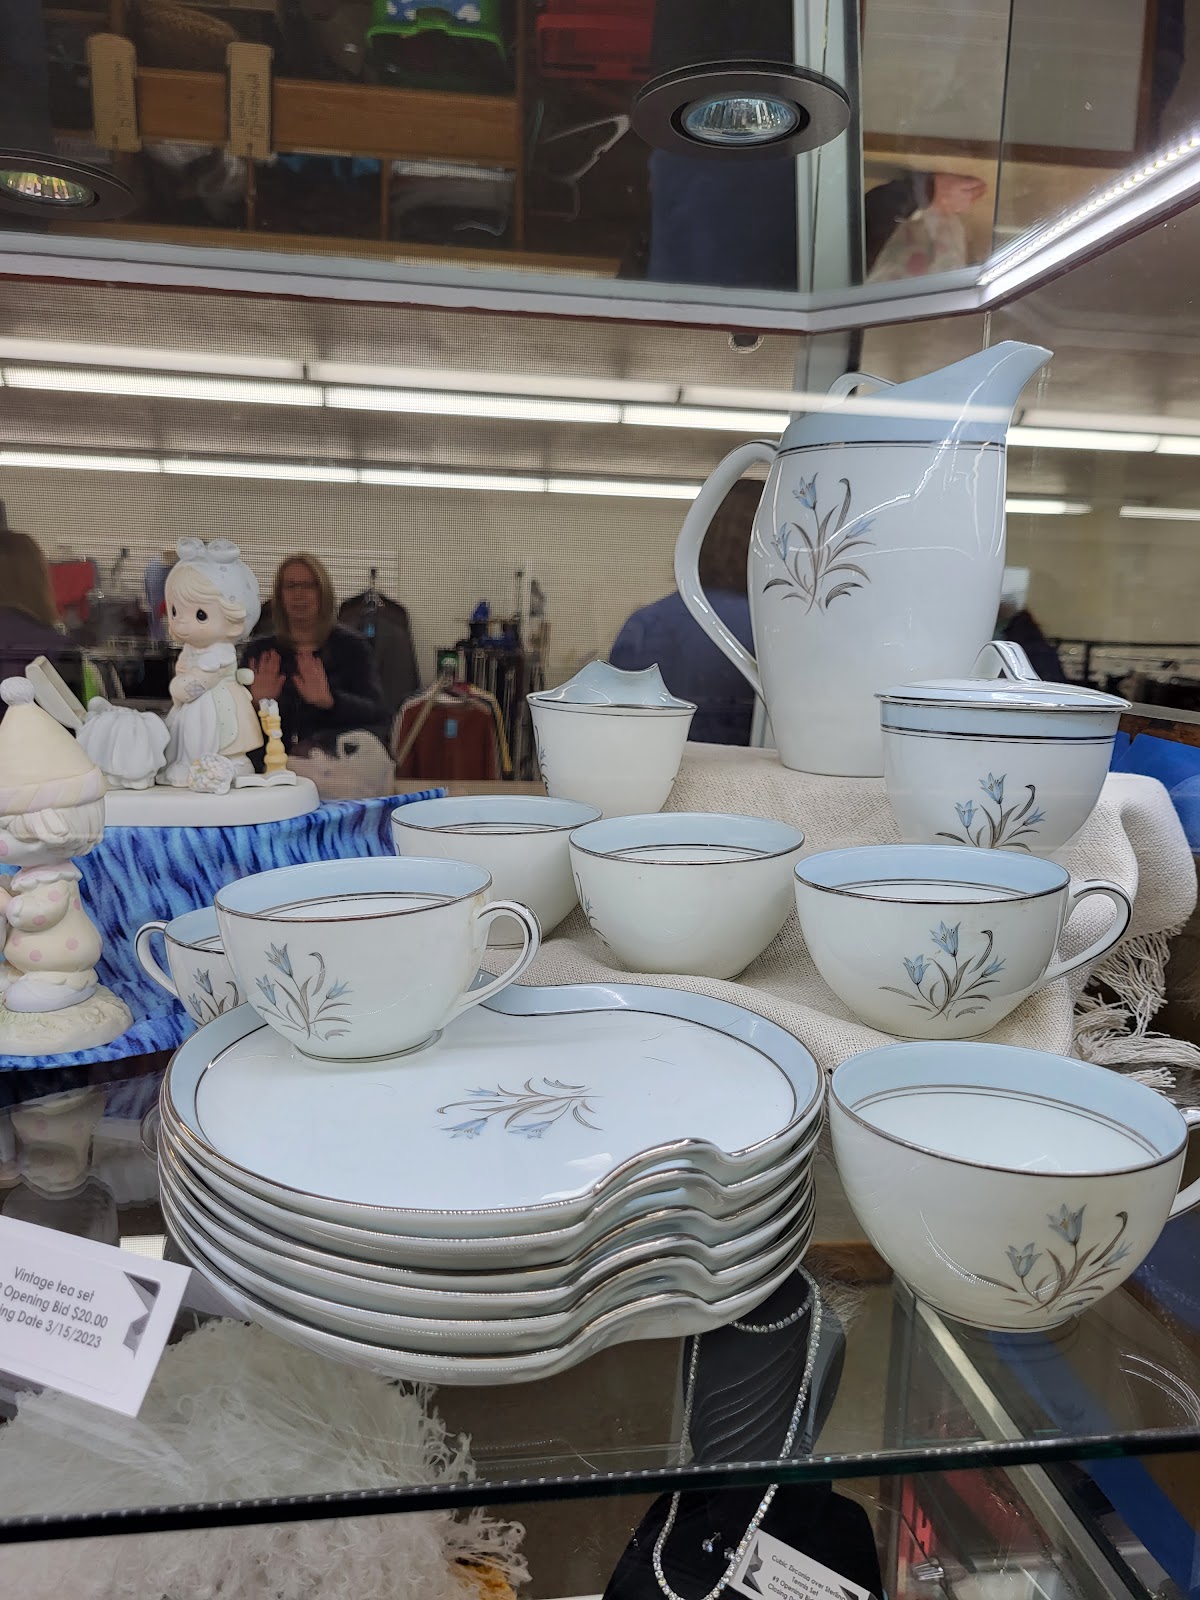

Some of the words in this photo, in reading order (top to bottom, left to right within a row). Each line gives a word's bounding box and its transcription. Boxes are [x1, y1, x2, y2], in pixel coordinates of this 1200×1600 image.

[14, 1266, 54, 1290] Vintage
[56, 1280, 75, 1296] tea
[77, 1290, 95, 1302] set
[4, 1284, 50, 1312] Opening
[52, 1300, 71, 1316] Bid
[71, 1306, 108, 1328] $20.00
[17, 1310, 43, 1329] Date
[45, 1319, 102, 1348] 3/15/2023
[772, 1555, 788, 1568] Cubic
[788, 1564, 810, 1581] Zirconia
[811, 1579, 824, 1589] over
[791, 1576, 809, 1591] Tennis
[810, 1587, 819, 1596] Set
[768, 1583, 788, 1599] Closing
[780, 1580, 804, 1599] Opening
